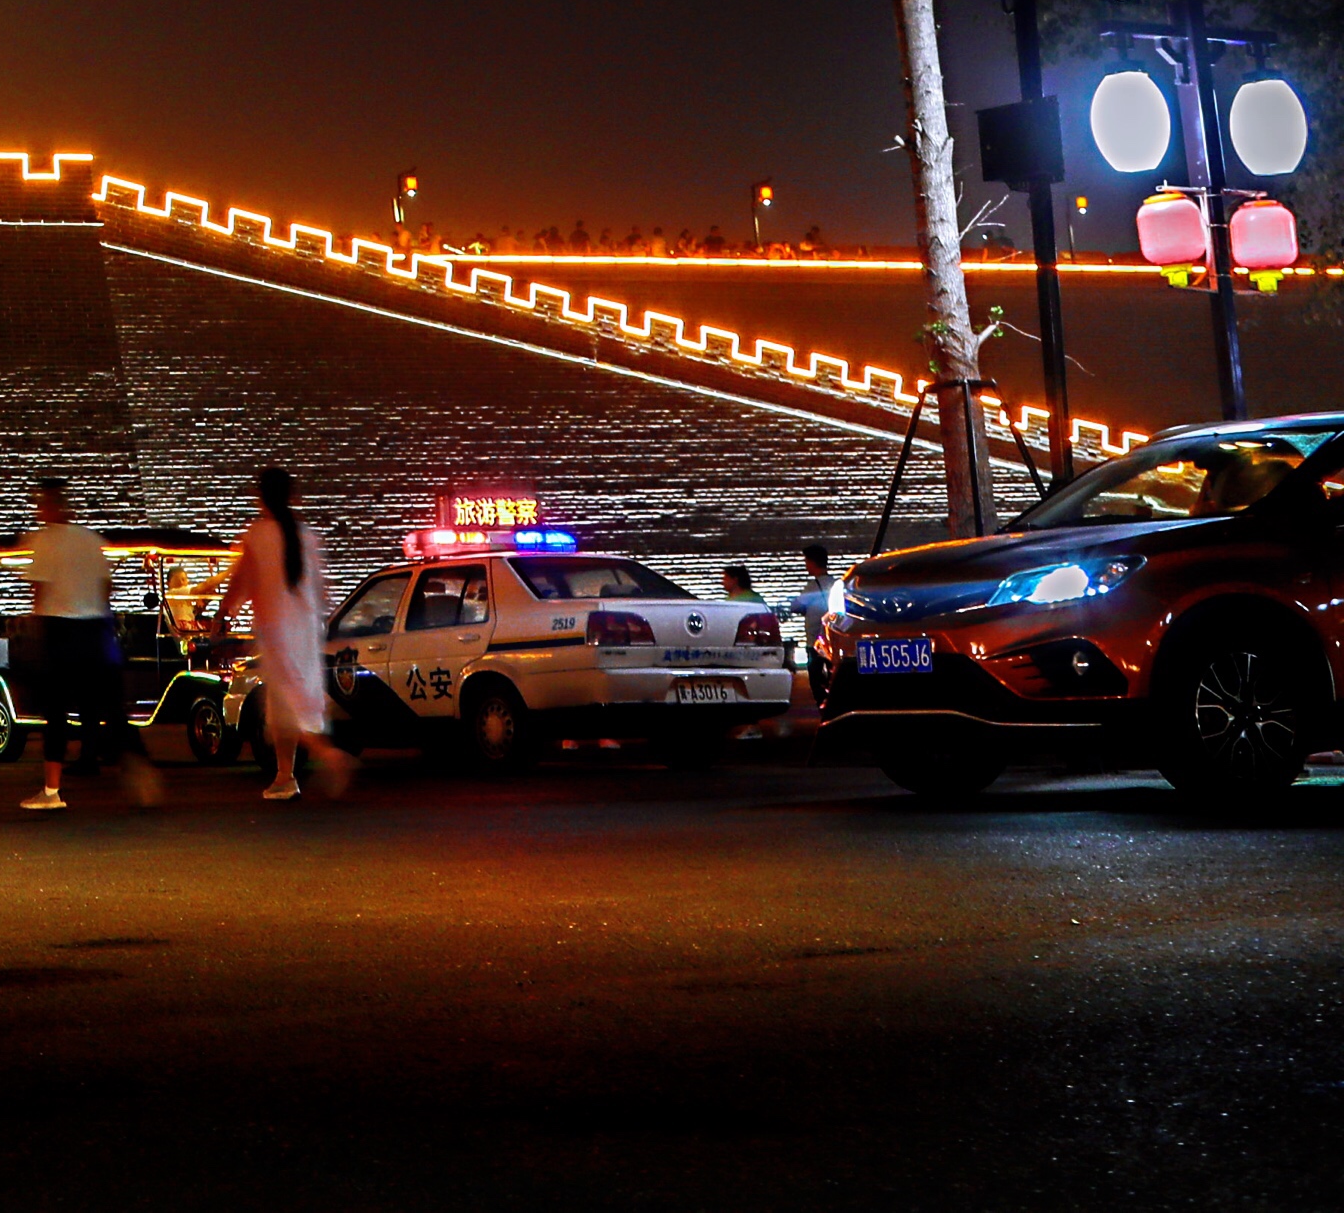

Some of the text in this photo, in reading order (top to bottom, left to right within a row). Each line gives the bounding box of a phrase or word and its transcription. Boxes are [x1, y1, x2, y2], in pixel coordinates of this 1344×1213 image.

[453, 497, 539, 526] 旅游警察
[551, 617, 576, 631] 2519
[406, 663, 454, 701] 公安
